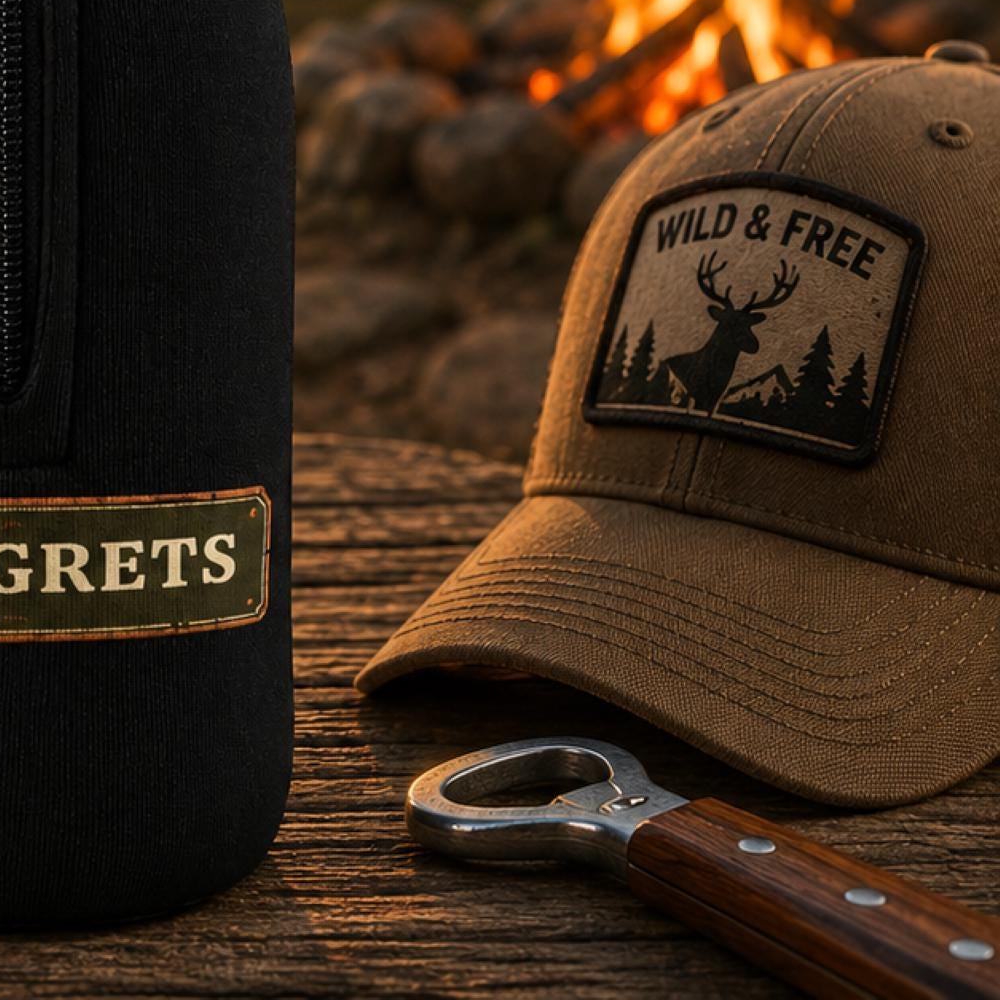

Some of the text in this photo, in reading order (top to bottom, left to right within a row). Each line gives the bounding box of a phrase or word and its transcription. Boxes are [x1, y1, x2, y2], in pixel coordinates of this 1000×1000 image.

[657, 203, 885, 280] WILD & FREE
